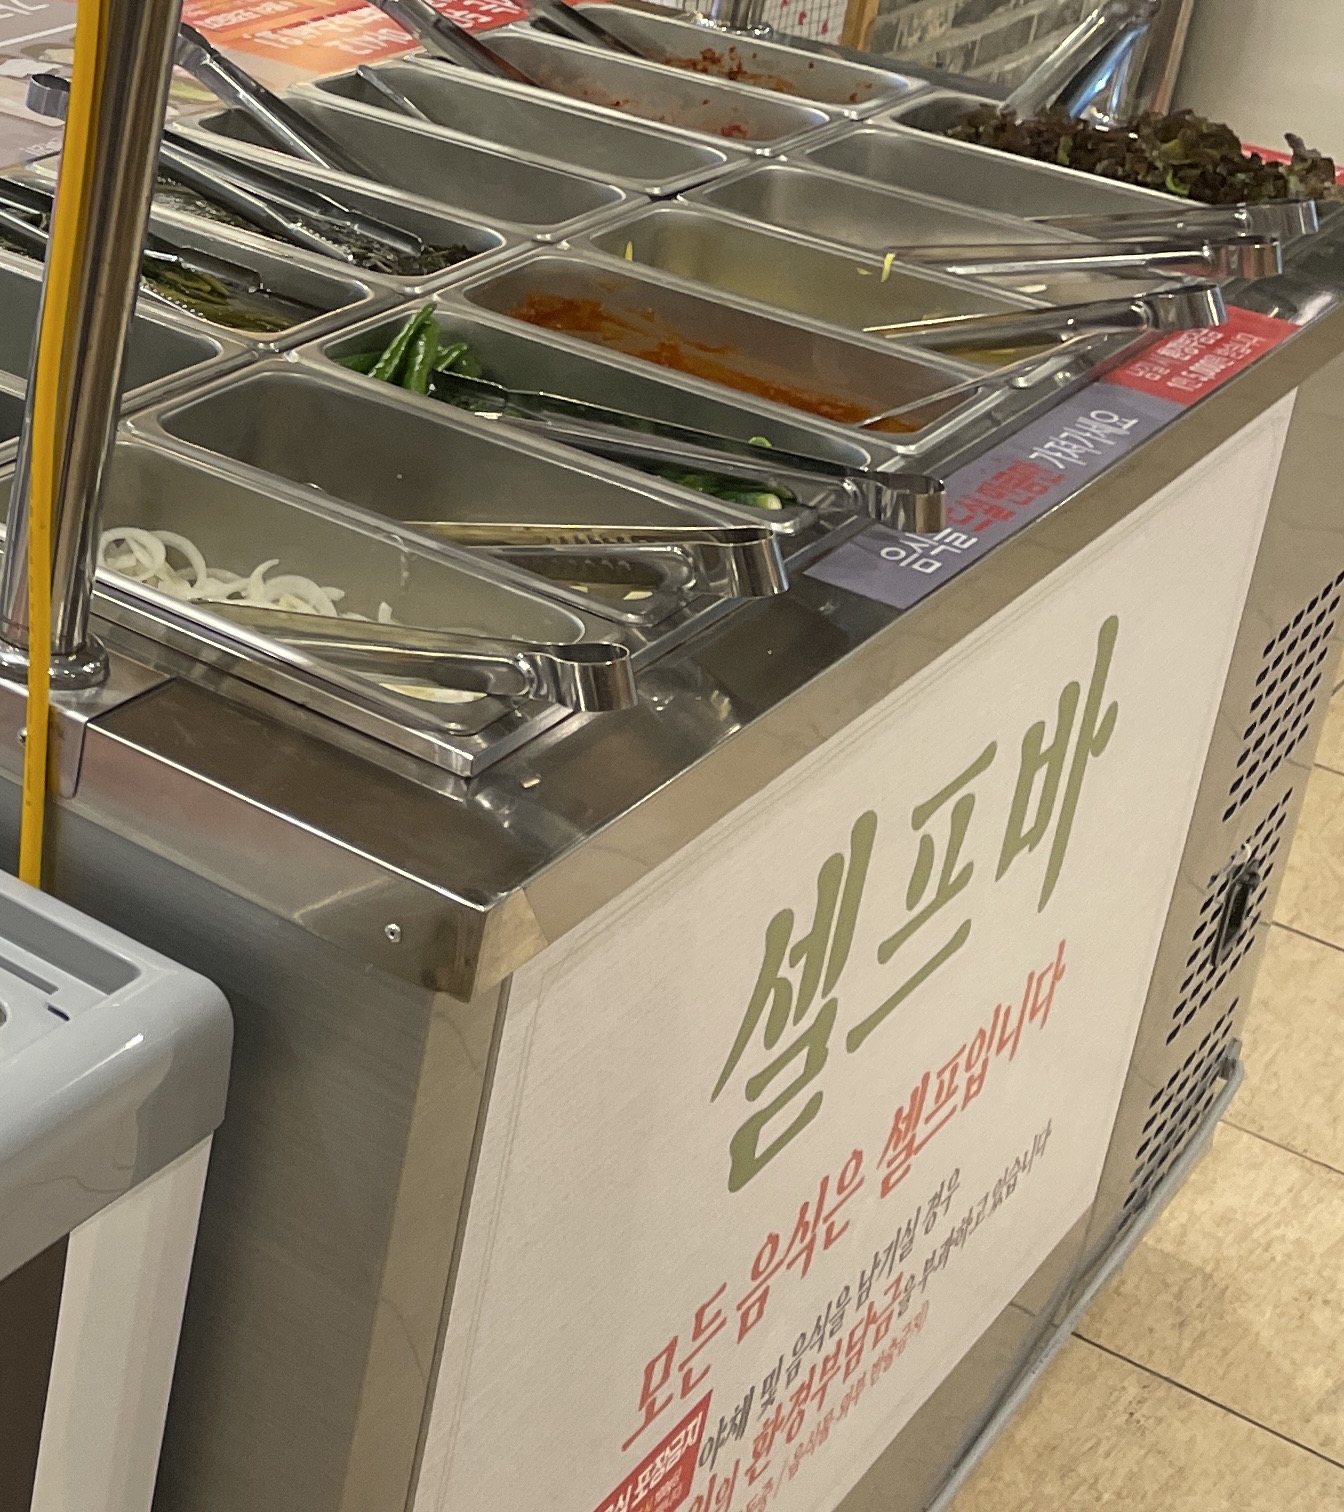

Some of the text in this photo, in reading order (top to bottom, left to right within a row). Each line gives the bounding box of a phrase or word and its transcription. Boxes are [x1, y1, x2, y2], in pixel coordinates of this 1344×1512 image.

[879, 526, 978, 575] 음식을
[1030, 409, 1140, 470] 가져가세요
[710, 613, 1121, 1195] 셀프바
[621, 1282, 728, 1453] 모든
[735, 1148, 866, 1345] 음식은
[876, 937, 1067, 1200] 셀프입니다
[699, 1167, 962, 1472] 야채 및 음식을 남기실 경우
[745, 1271, 917, 1487] 환경부담금을
[917, 1190, 990, 1294] 부과하고
